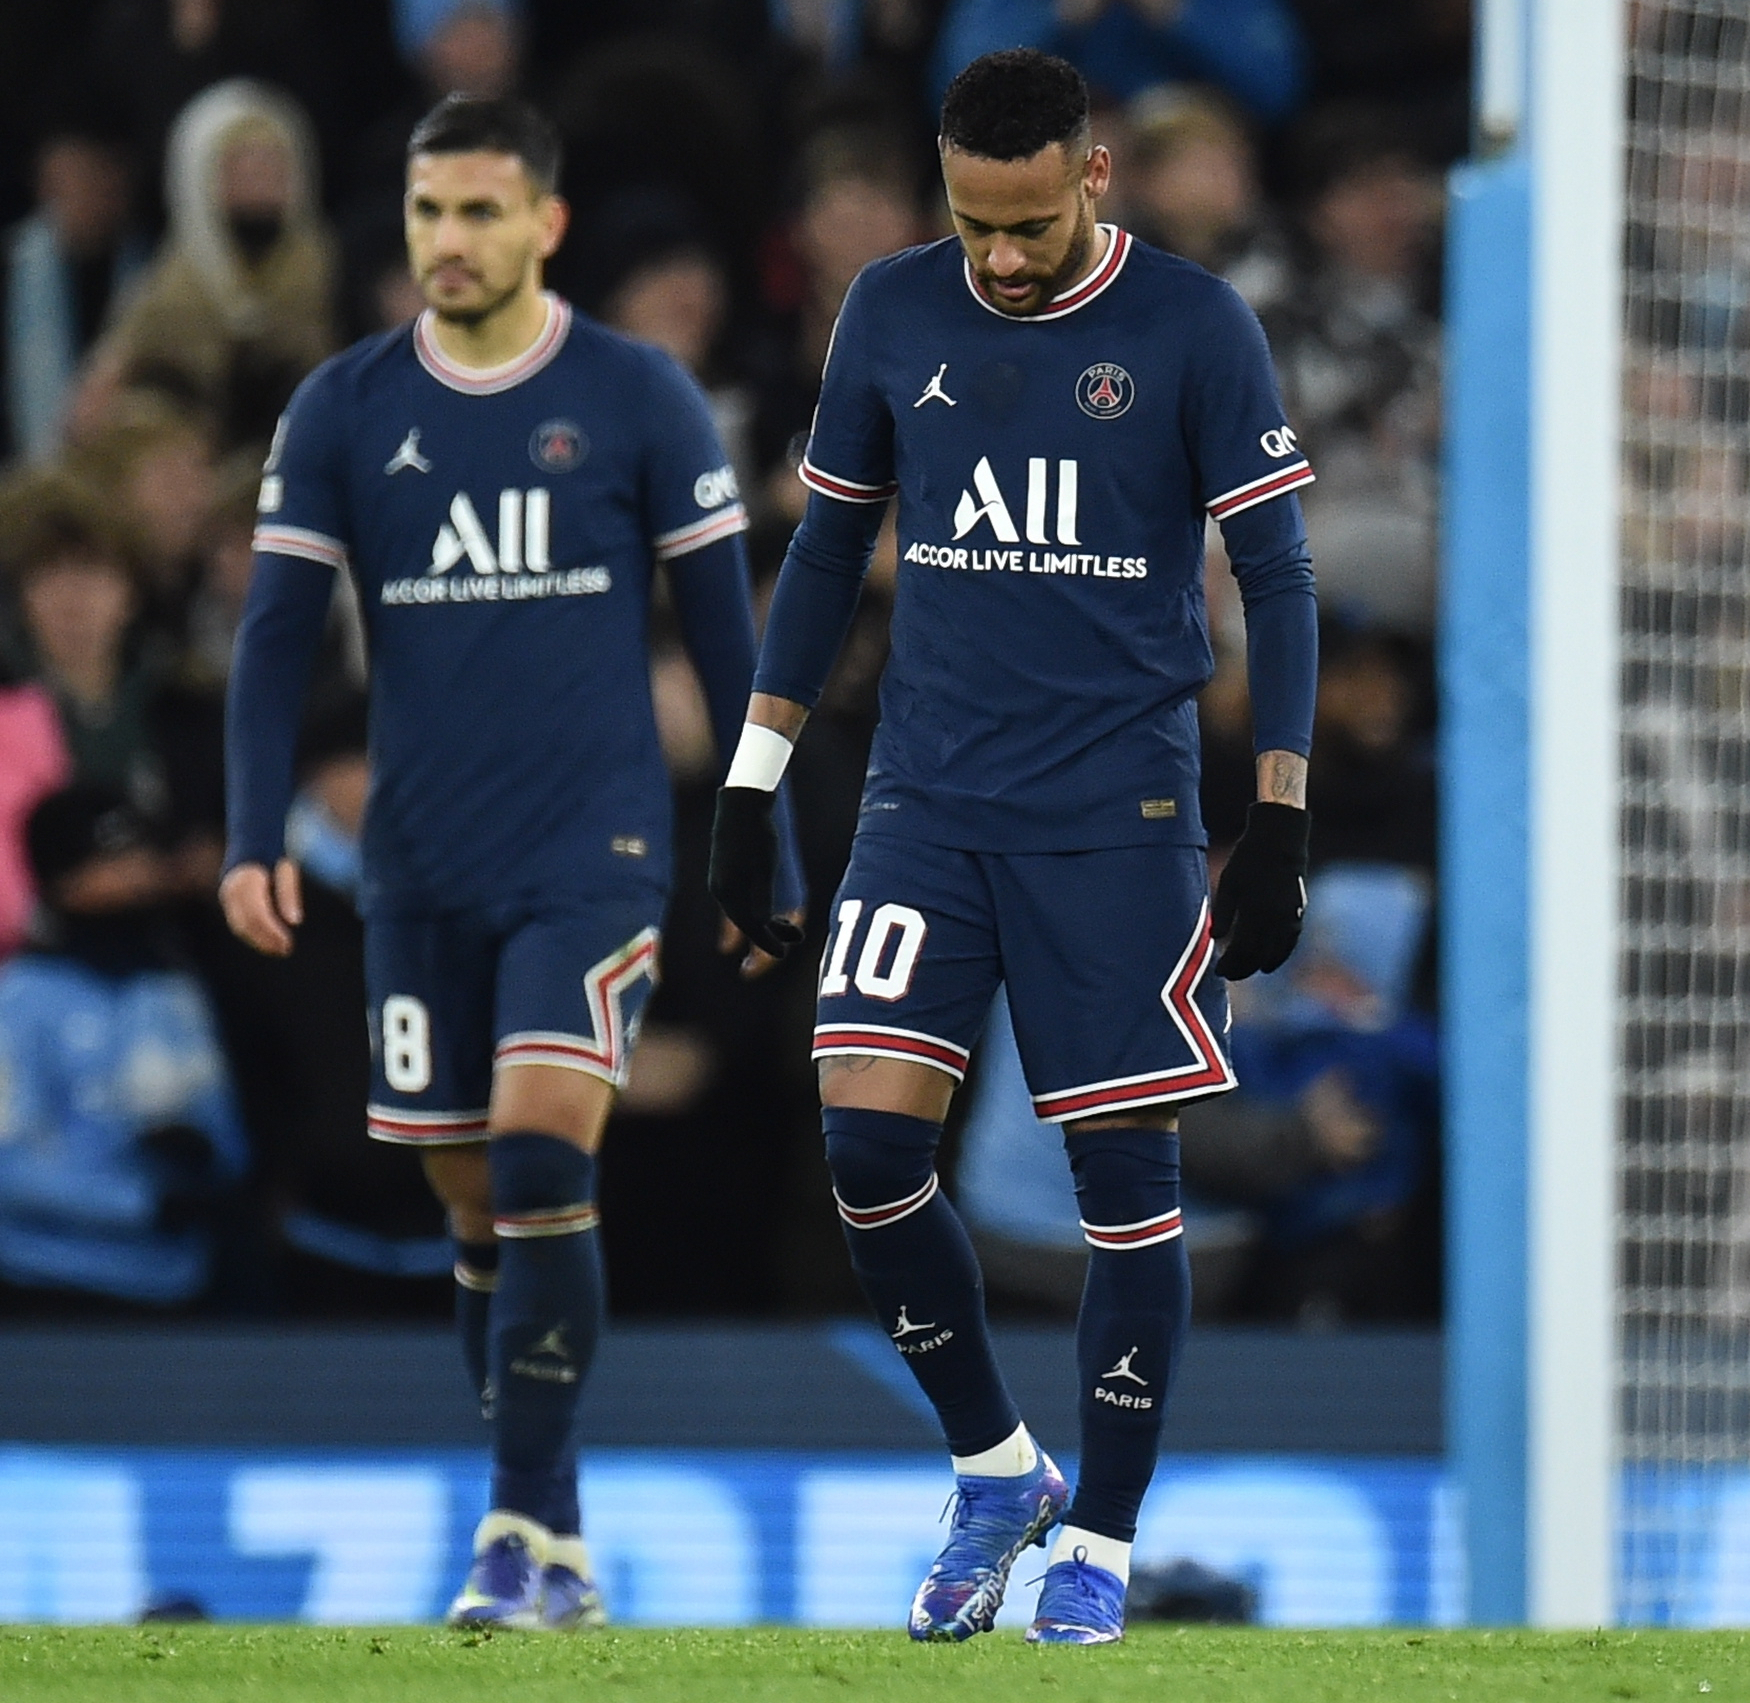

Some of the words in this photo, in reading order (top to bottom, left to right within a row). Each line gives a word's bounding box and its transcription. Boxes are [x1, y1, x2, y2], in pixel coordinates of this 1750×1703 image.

[1087, 366, 1127, 382] PARIS
[904, 542, 968, 570] ACCOR
[971, 550, 1024, 572] LIVE
[1029, 552, 1148, 579] LIMITLESS
[820, 899, 928, 1002] 10
[382, 993, 432, 1094] 8
[895, 1329, 954, 1354] PARIS
[1094, 1386, 1153, 1409] PARIS
